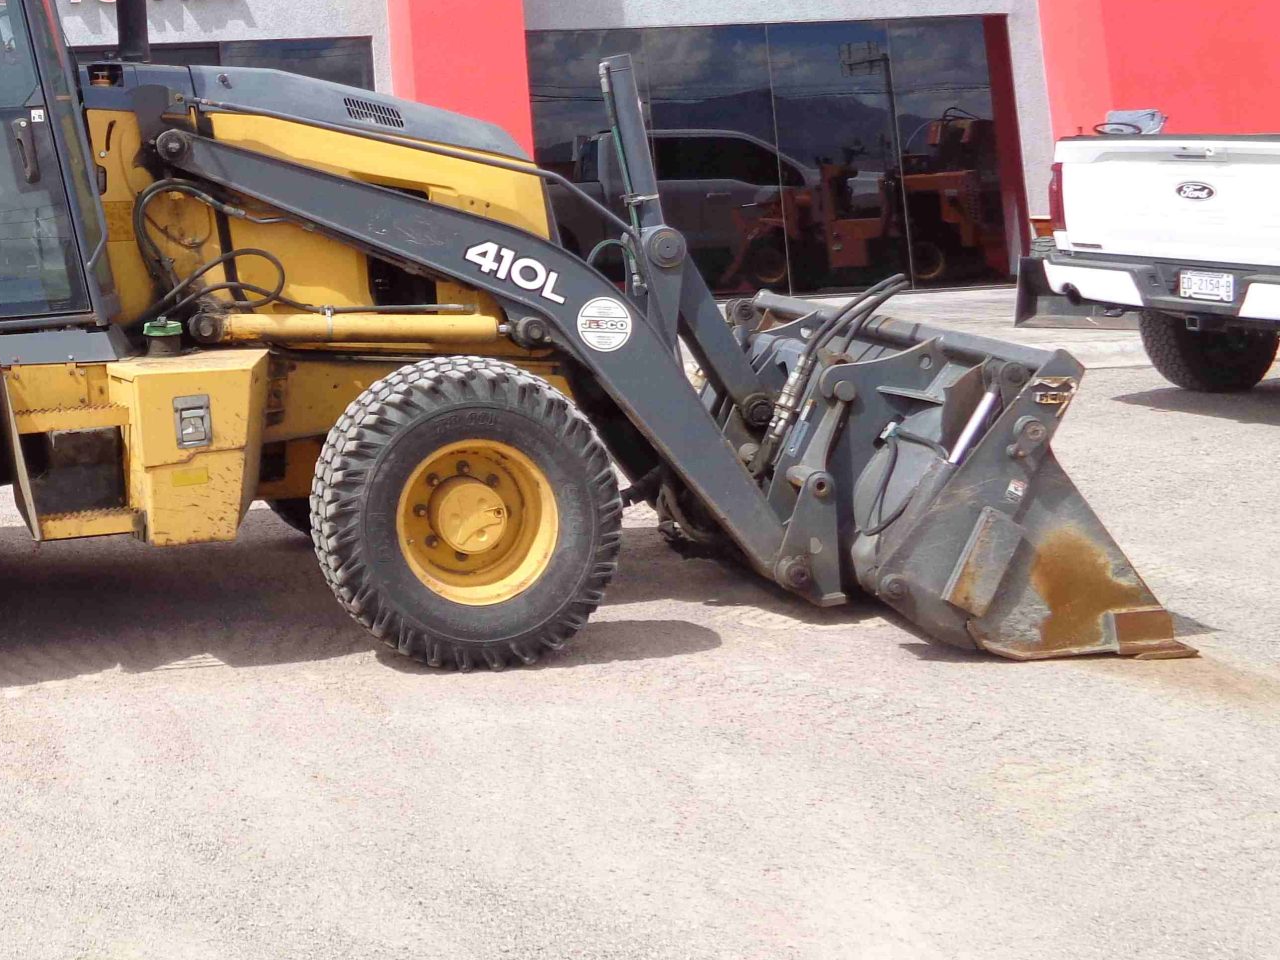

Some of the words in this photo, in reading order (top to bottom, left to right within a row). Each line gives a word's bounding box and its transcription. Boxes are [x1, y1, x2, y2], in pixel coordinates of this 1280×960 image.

[1179, 183, 1210, 200] Ford
[465, 241, 566, 305] 410L
[580, 319, 628, 330] JESCO
